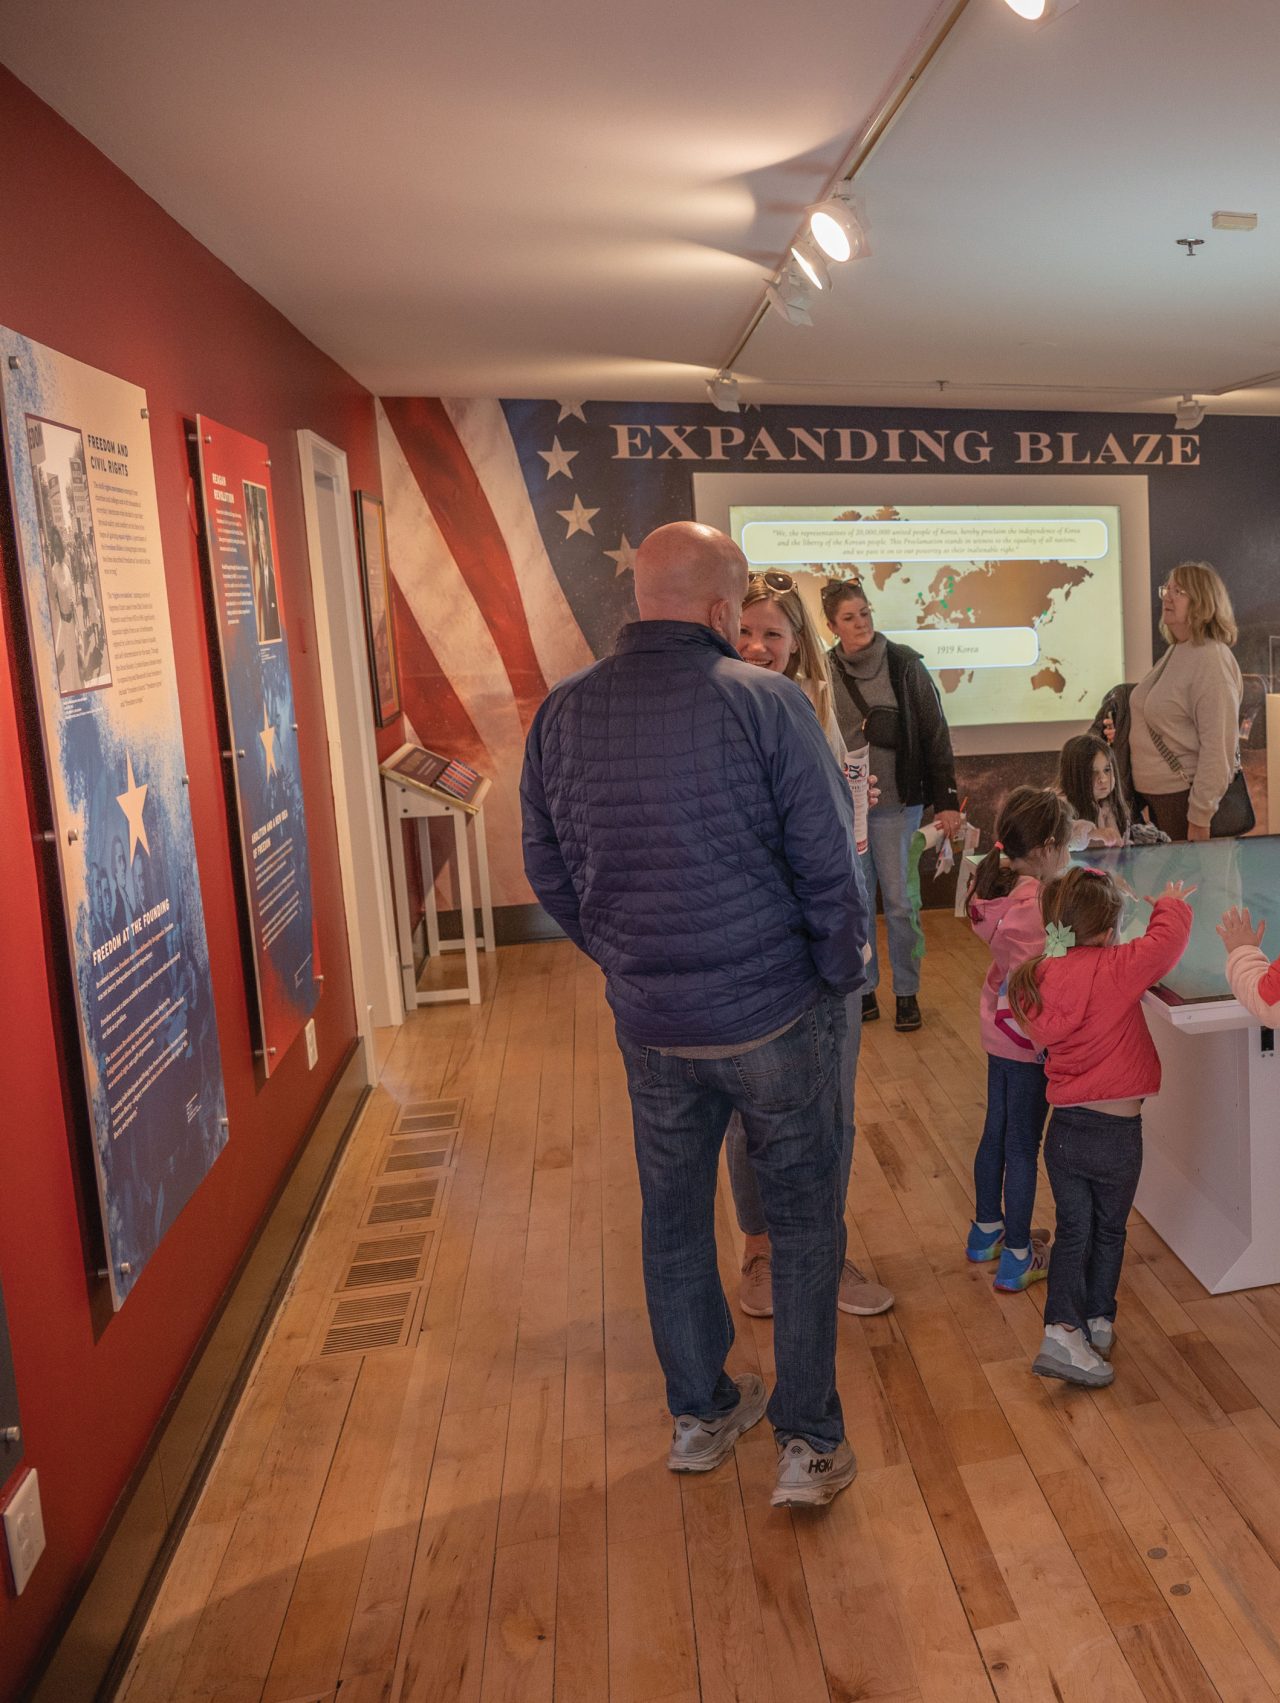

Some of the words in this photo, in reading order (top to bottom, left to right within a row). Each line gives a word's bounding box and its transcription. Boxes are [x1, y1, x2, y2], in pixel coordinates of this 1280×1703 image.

[87, 434, 115, 455] FREEDOM
[117, 444, 129, 458] AND
[609, 424, 992, 464] EXPANDING
[1013, 431, 1200, 466] BLAZE
[90, 455, 107, 473] CIVIL
[107, 456, 129, 477] RIGHTS
[936, 646, 955, 655] 1919
[956, 646, 980, 654] Korea
[92, 933, 122, 967] FREEDOM
[122, 926, 130, 944] AT
[130, 917, 143, 937] THE
[143, 897, 170, 928] FOUNDING
